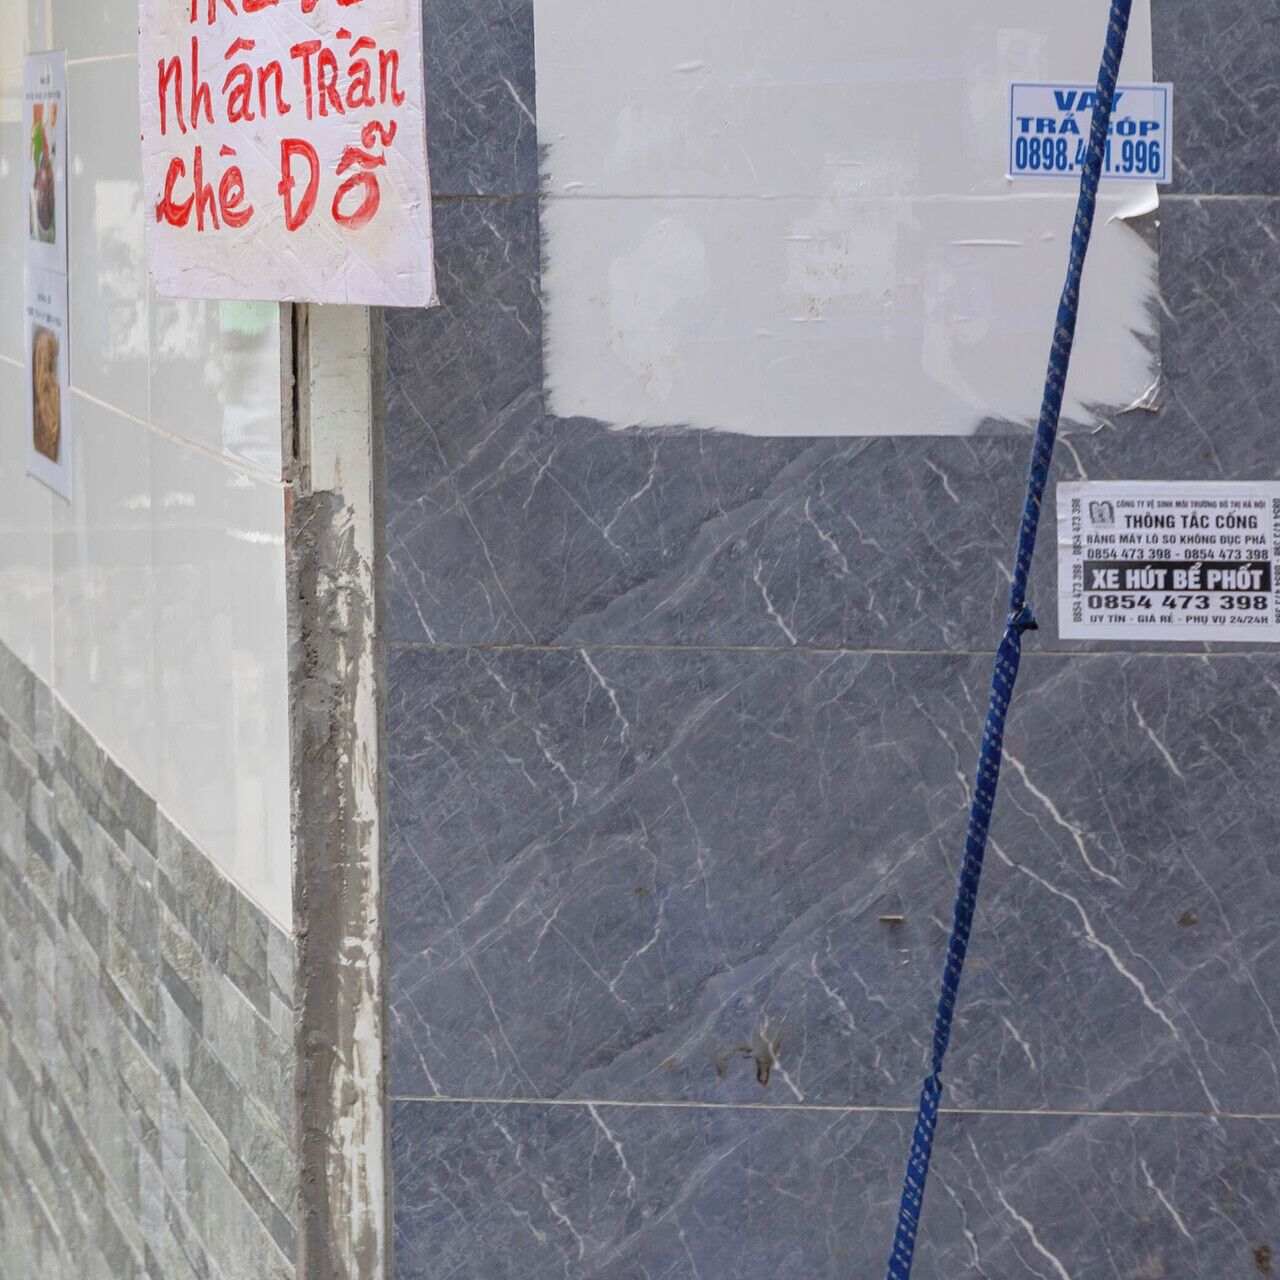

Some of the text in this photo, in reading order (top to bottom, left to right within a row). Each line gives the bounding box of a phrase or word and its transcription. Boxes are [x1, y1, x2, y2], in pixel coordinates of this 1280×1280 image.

[1017, 113, 1080, 135] TRẢ
[1015, 136, 1161, 174] 0898.41.996
[1124, 511, 1175, 528] THÔNG
[1215, 509, 1258, 528] CỐNG
[1180, 533, 1216, 544] KHÔNG
[1087, 548, 1117, 559] 0854
[1121, 548, 1144, 559] 473
[1148, 548, 1171, 559] 398
[1184, 549, 1215, 560] 0854
[1219, 549, 1242, 560] 473
[1246, 549, 1269, 560] 398
[1091, 562, 1264, 590] XE HÚT BỂ PHỐT
[1088, 595, 1268, 610] 0854 473 398
[1090, 615, 1106, 623] UY
